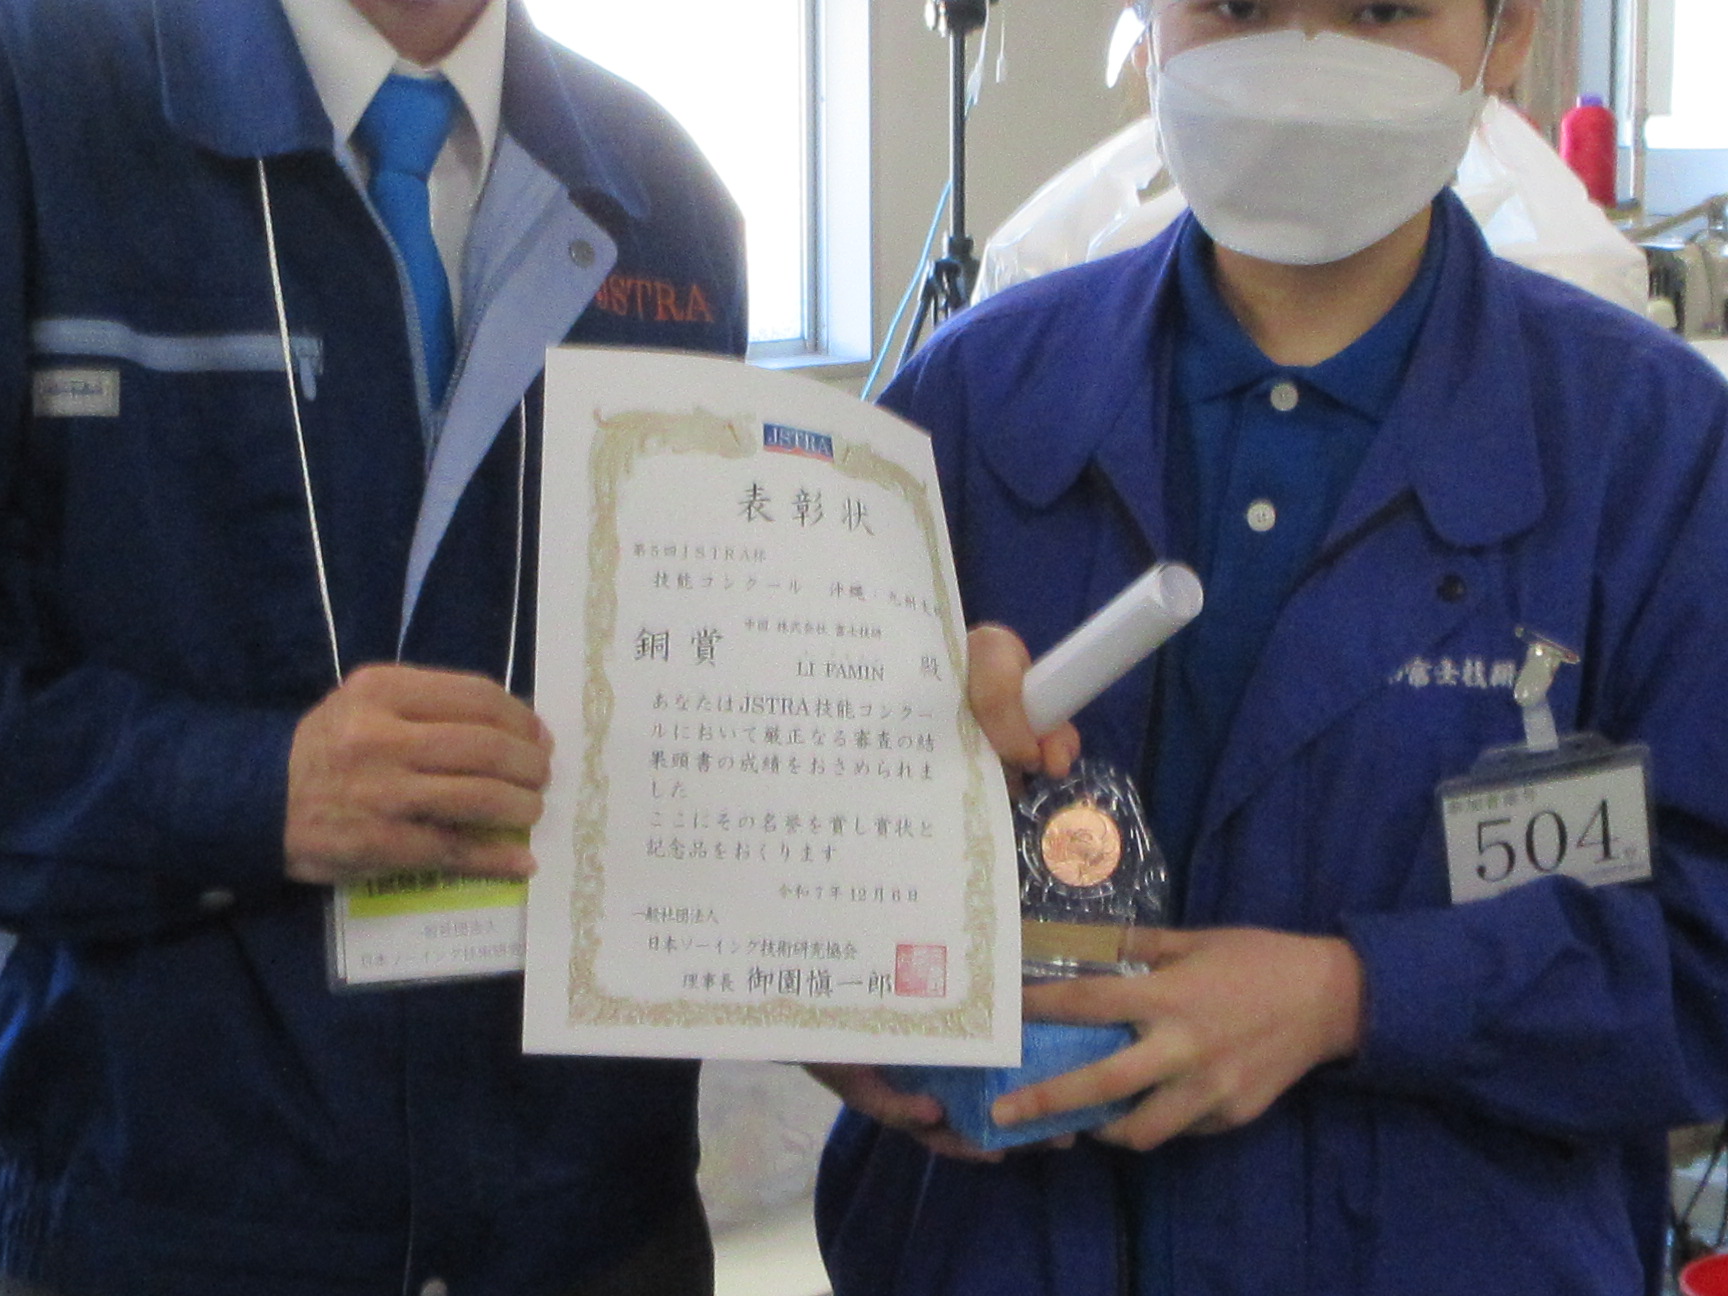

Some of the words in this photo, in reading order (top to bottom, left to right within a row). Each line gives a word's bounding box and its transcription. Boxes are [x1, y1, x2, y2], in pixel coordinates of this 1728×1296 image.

[766, 426, 833, 458] JSTRA
[737, 482, 875, 537] 表彰状
[633, 625, 724, 668] 銅賞
[1476, 797, 1621, 883] 504
